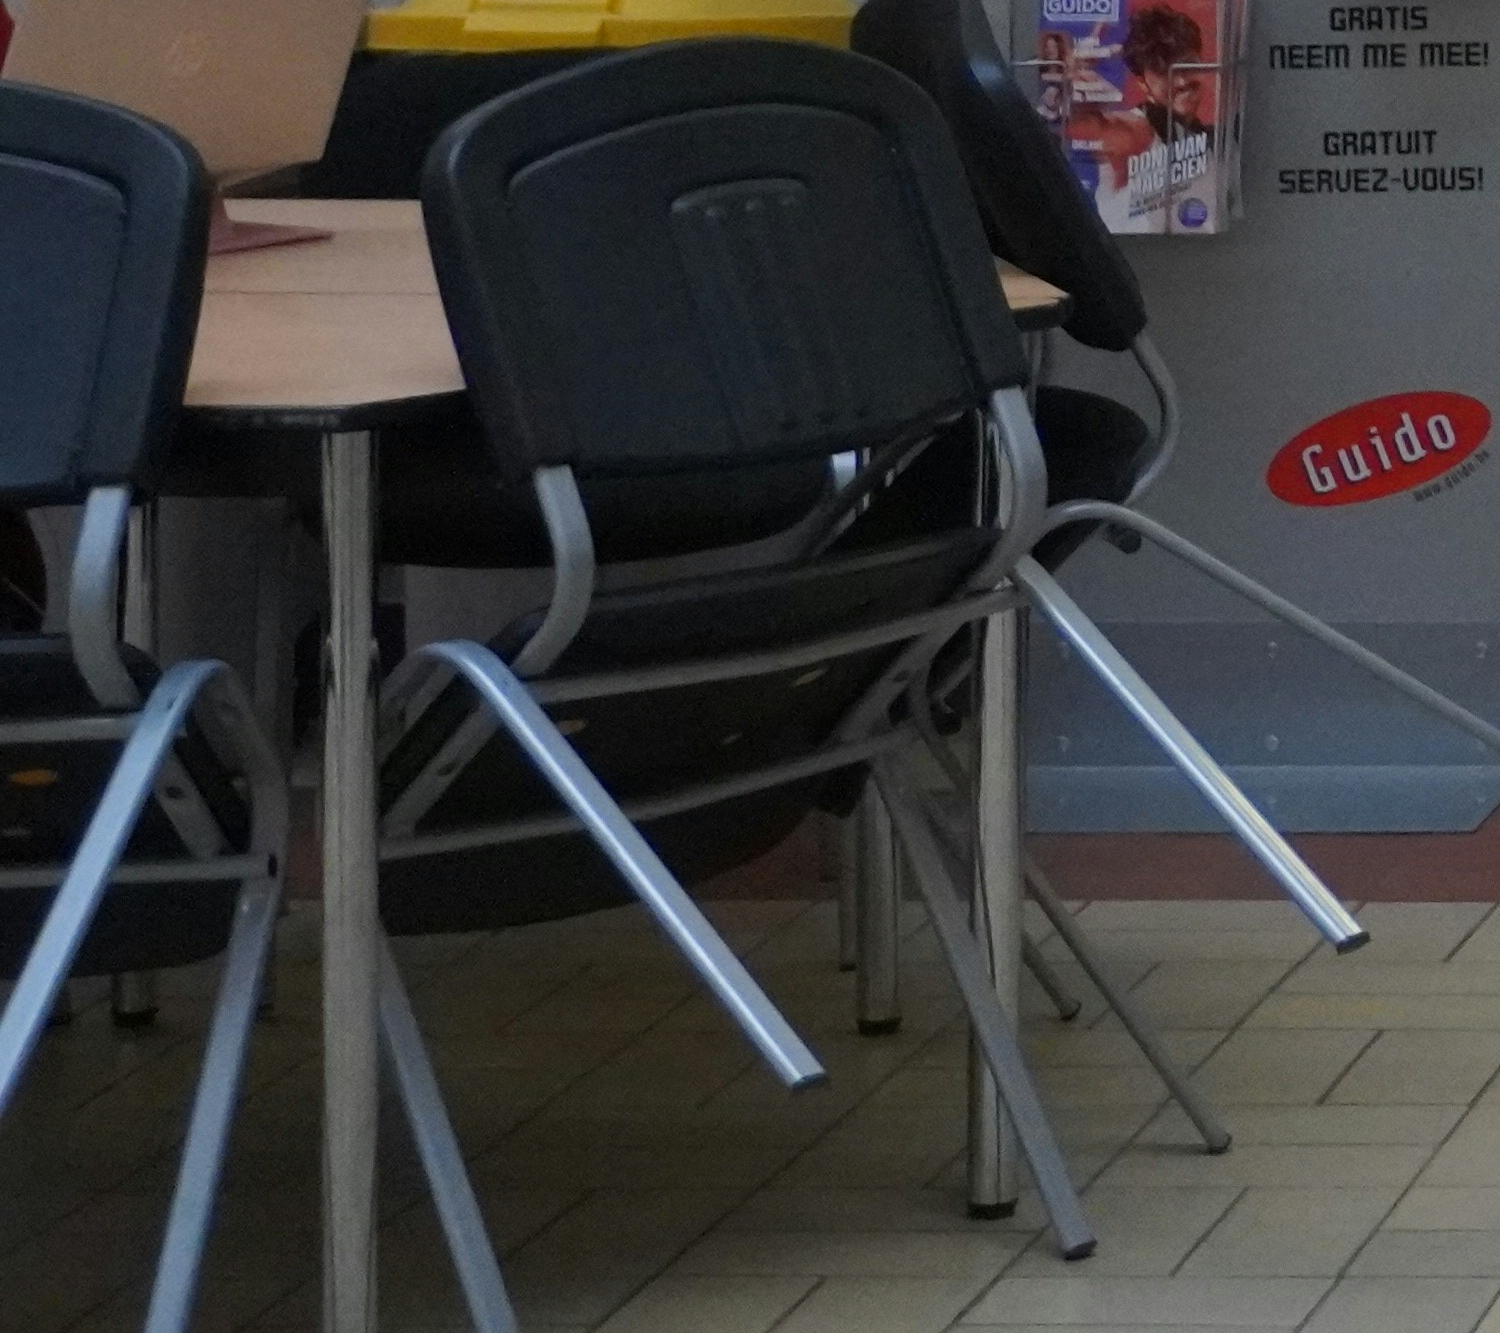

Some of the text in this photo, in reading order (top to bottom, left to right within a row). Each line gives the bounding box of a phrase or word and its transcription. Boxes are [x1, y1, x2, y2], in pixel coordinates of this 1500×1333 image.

[1330, 6, 1428, 31] GRATIS
[1323, 130, 1437, 156] GRATUIT
[1279, 167, 1484, 194] SERVEZ-VOUS!
[1302, 412, 1457, 493] Guido
